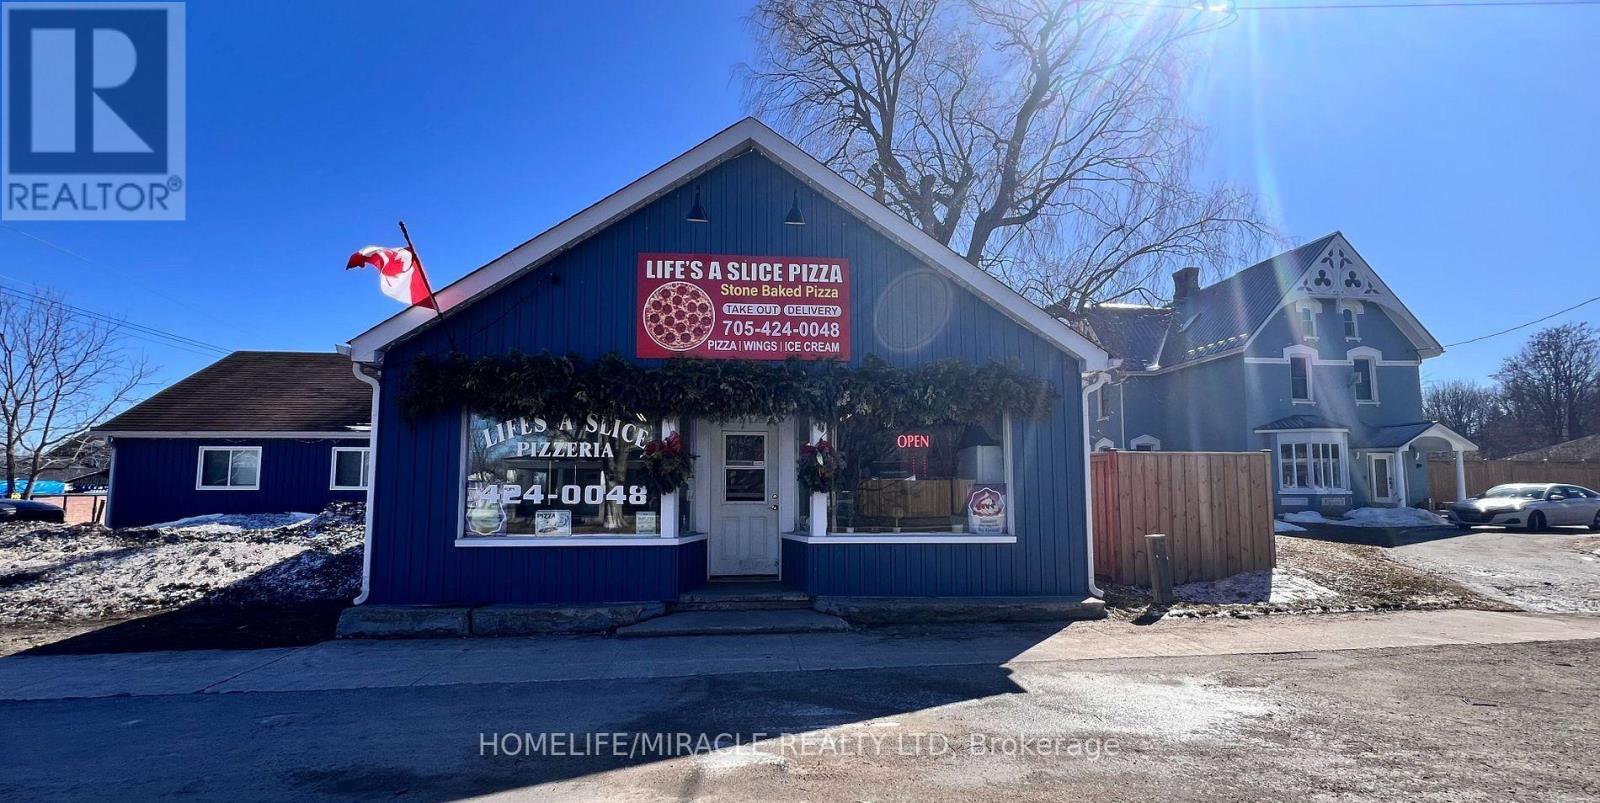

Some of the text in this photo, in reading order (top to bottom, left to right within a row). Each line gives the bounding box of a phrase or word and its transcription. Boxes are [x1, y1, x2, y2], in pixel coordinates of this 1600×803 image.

[646, 260, 843, 283] LIFE'S A SLICE PIZZA
[720, 283, 839, 298] Stone Baked Pizza
[726, 304, 778, 315] TAKE OUT
[787, 306, 838, 316] DELIVERY
[722, 320, 840, 338] 705-424-0048
[707, 340, 840, 353] PIZZA WINGS ICE CREAM
[559, 414, 573, 431] A
[585, 413, 649, 449] SLICE
[897, 434, 929, 448] OPEN
[516, 442, 614, 458] PIZZERIA
[479, 484, 648, 505] 424-0048
